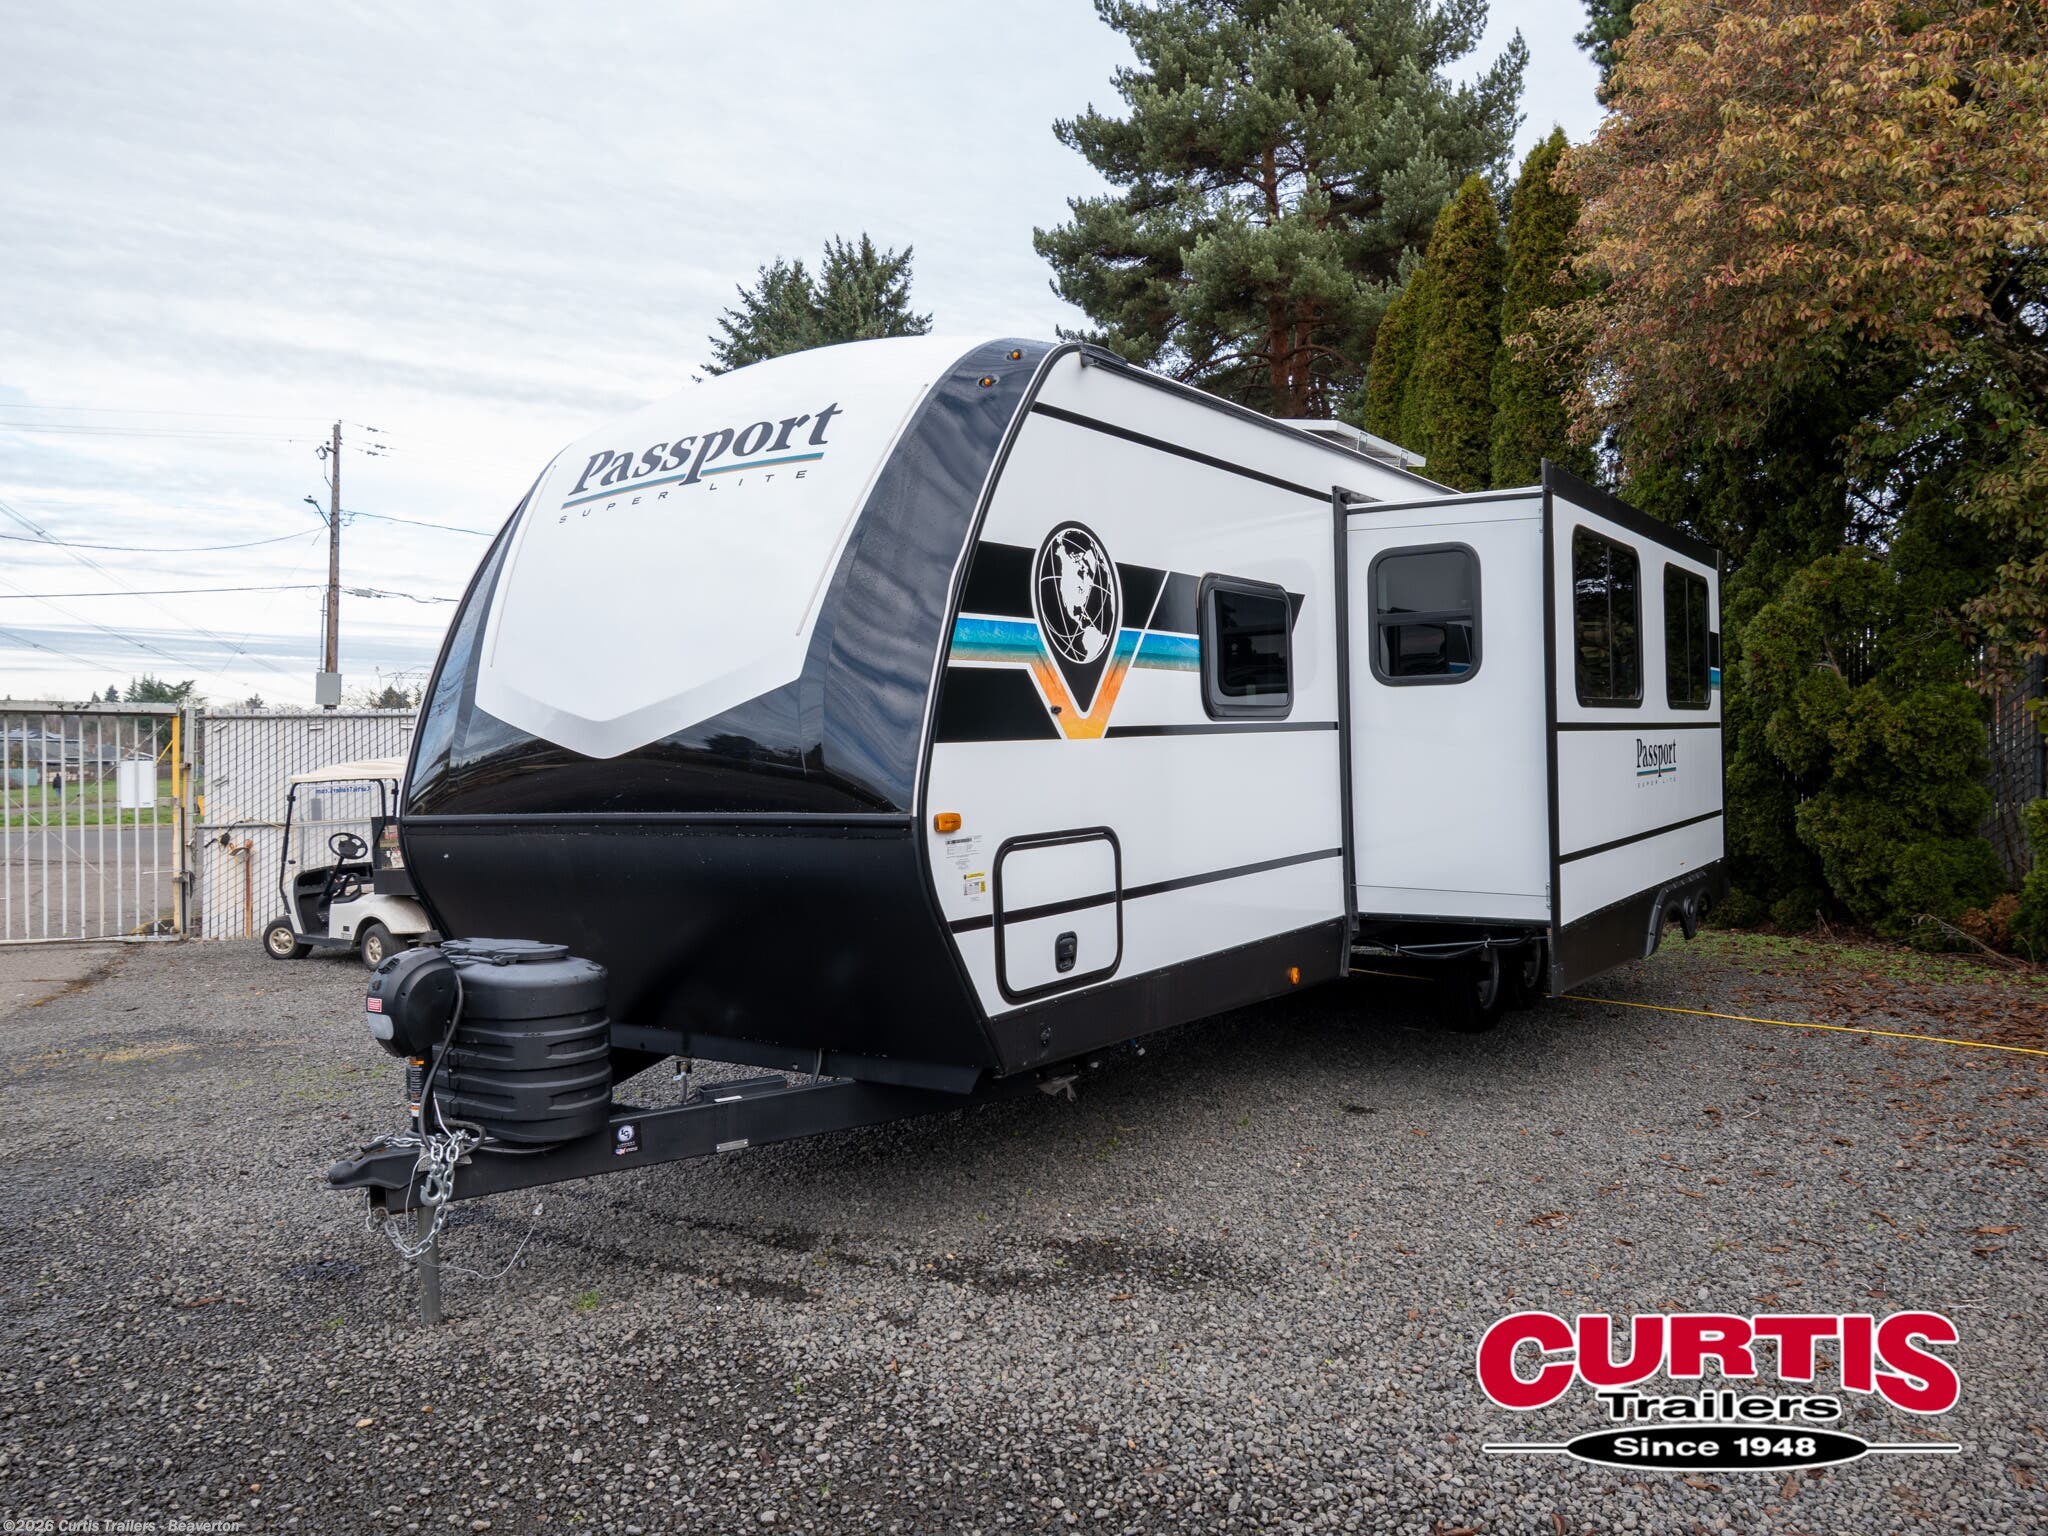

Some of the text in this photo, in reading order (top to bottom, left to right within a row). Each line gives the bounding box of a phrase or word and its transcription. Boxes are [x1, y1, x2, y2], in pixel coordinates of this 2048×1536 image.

[567, 402, 843, 496] Passport
[559, 470, 807, 523] SUPER LITE
[1636, 737, 1677, 777] Passport
